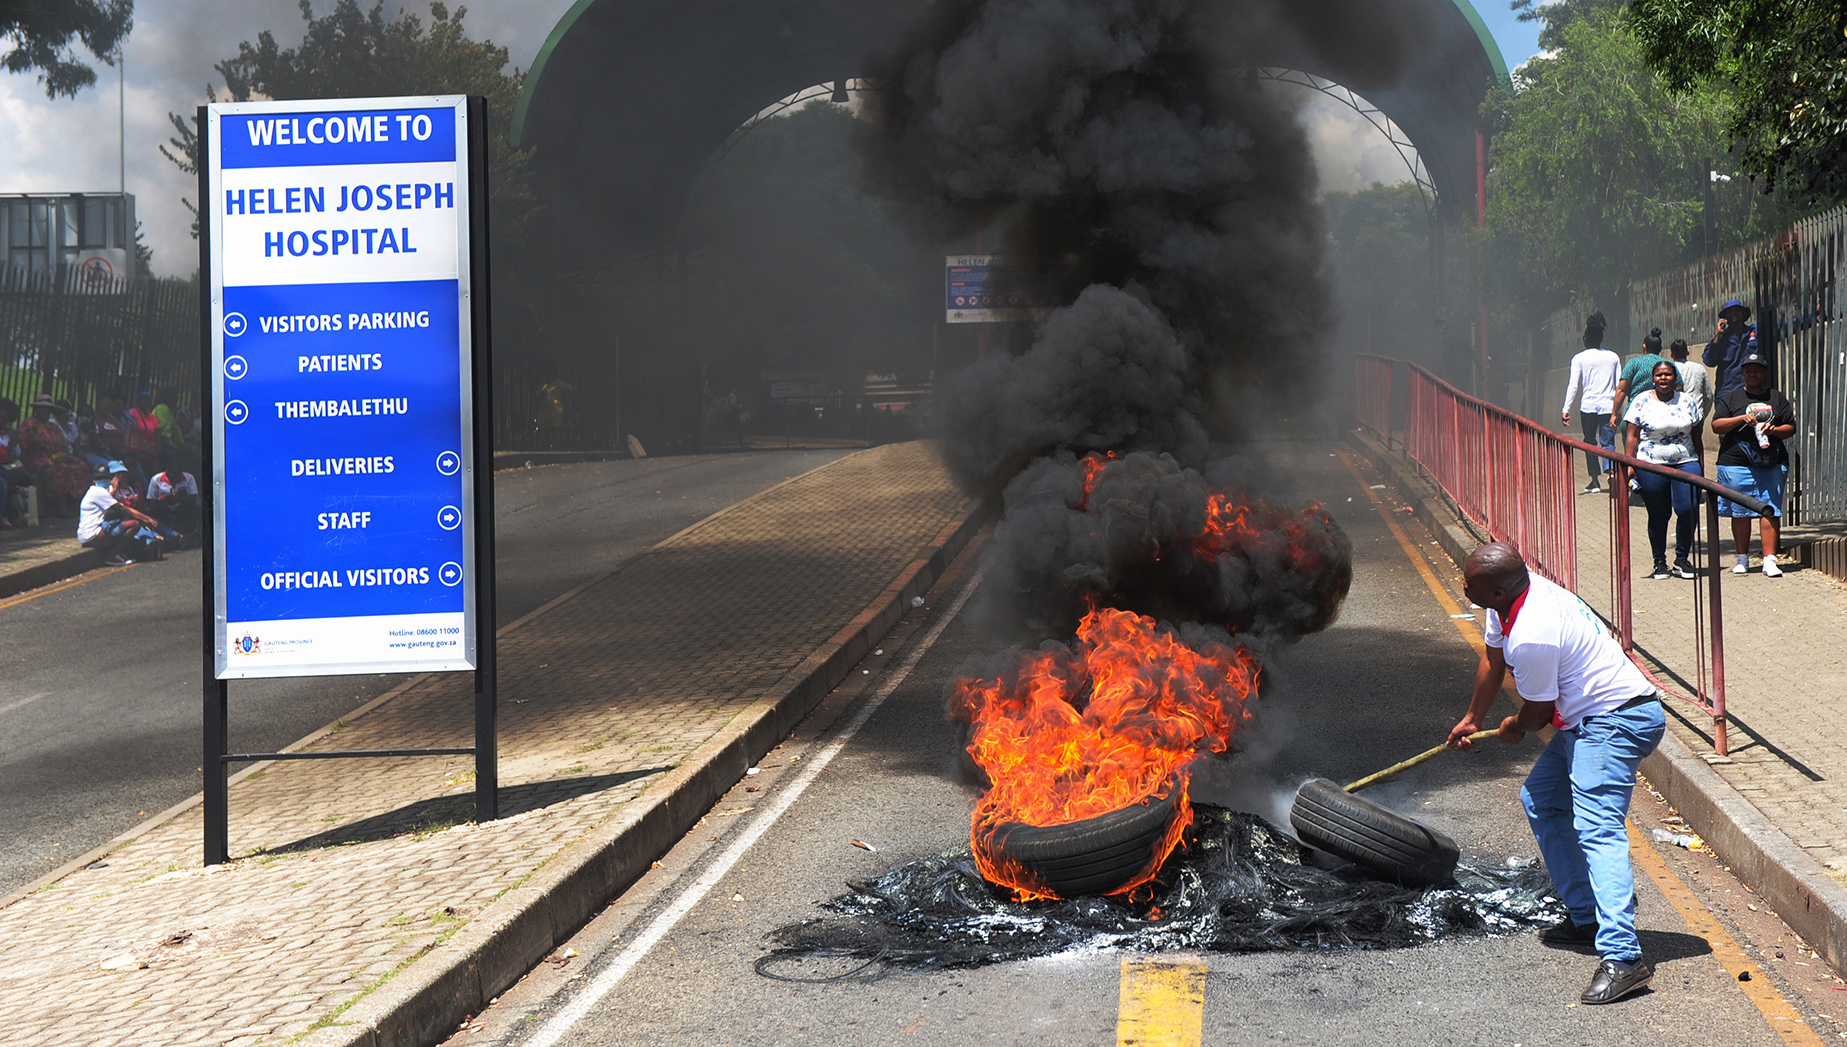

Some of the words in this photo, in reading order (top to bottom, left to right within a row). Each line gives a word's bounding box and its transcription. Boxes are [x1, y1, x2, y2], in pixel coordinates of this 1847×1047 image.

[247, 116, 389, 146] WELCOME
[396, 114, 433, 141] TO
[225, 187, 325, 215] HELEN
[336, 182, 455, 212] JOSEPH
[264, 227, 418, 257] HOSPITAL
[957, 258, 986, 266] HELEN
[259, 314, 343, 333] VISITORS
[348, 310, 430, 330] PARKING
[298, 353, 383, 373] PATIENTS
[274, 397, 409, 419] THEMBALETHU
[291, 456, 395, 477] DELIVERIES
[317, 511, 371, 530] STAFF
[260, 570, 343, 590] OFFICIAL
[346, 567, 430, 587] VISITORS
[389, 629, 416, 637] Hotline:
[416, 628, 438, 636] 08600
[439, 627, 460, 635] 11000
[389, 639, 457, 649] www.gauteng.gov.za
